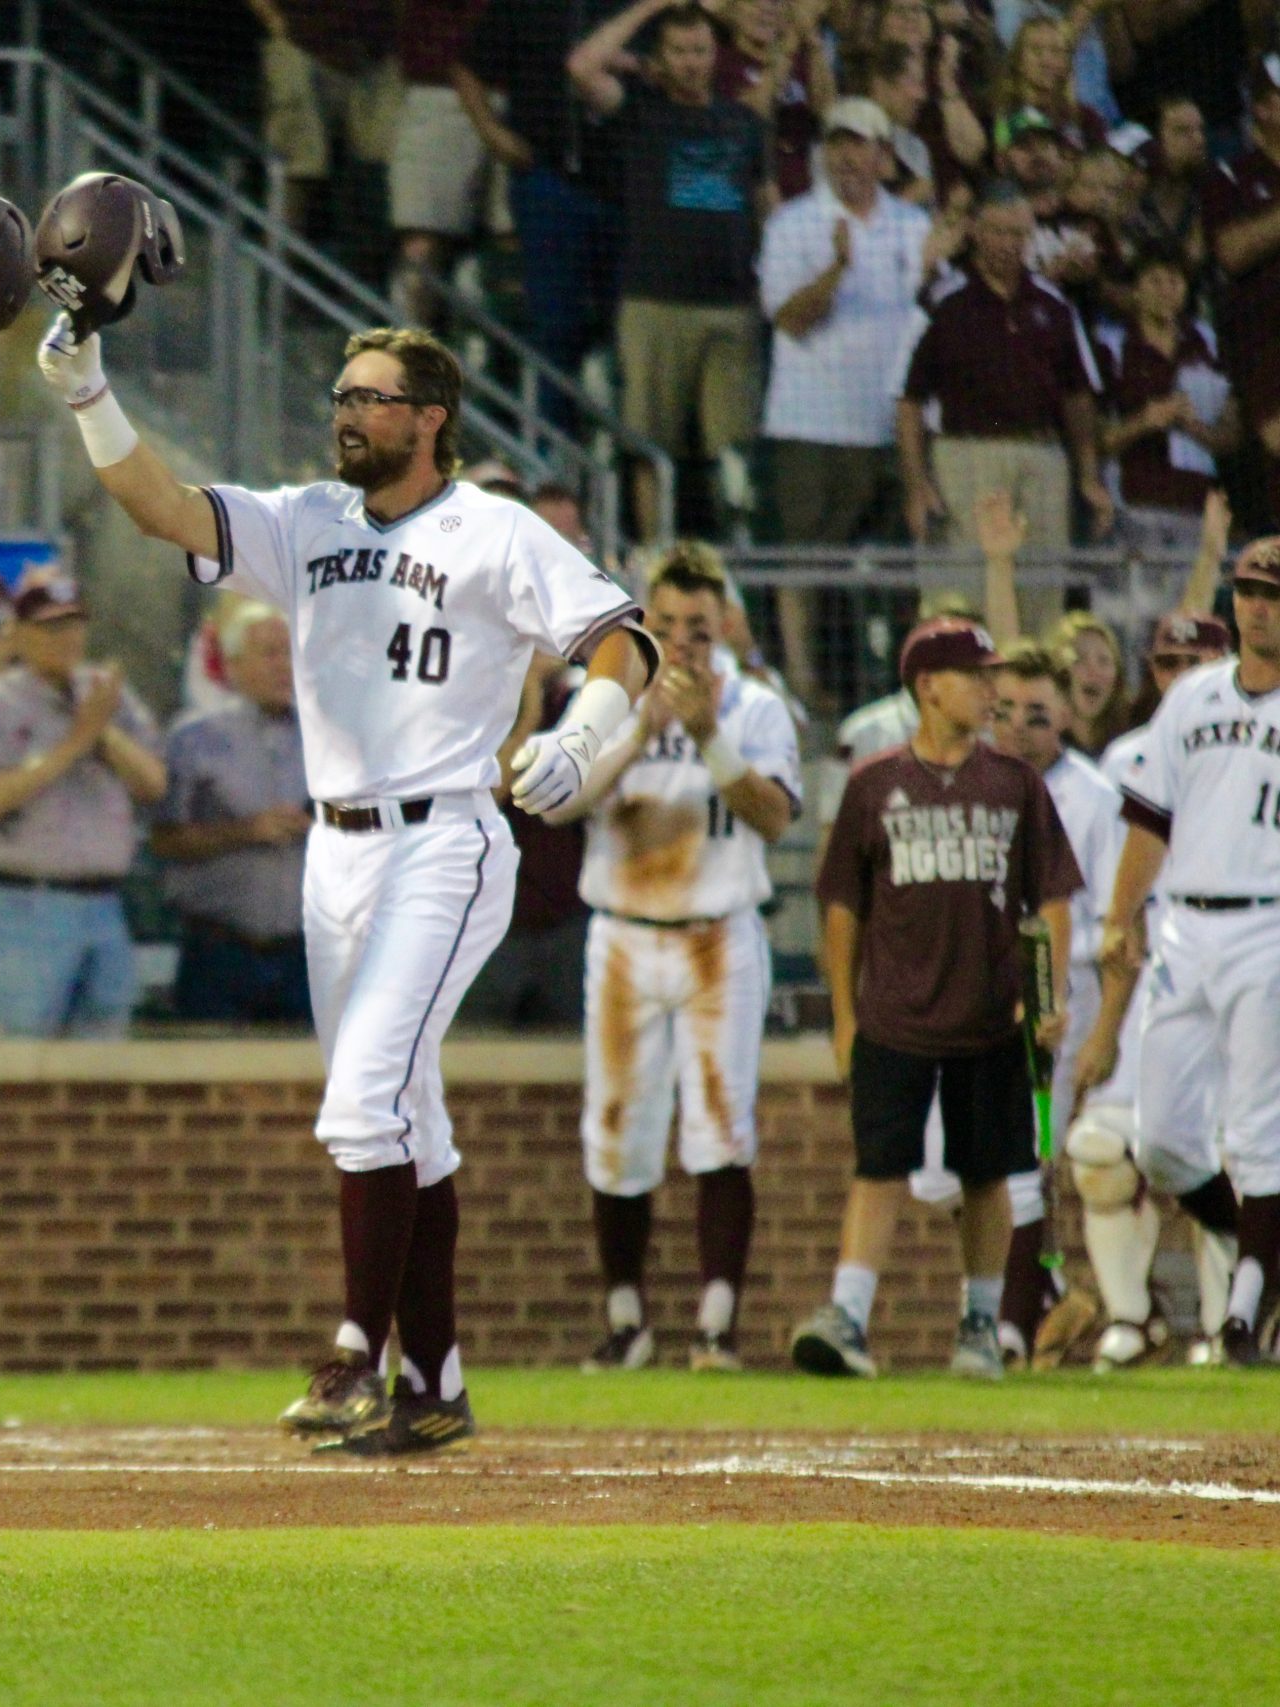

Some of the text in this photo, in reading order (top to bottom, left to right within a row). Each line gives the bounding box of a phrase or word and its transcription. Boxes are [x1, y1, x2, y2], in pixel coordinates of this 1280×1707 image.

[306, 547, 449, 612] TEXAS A&M
[385, 620, 452, 686] 40
[1182, 720, 1259, 758] TEXAS
[882, 804, 968, 845] TEXAS
[890, 834, 1010, 887] AGGIES
